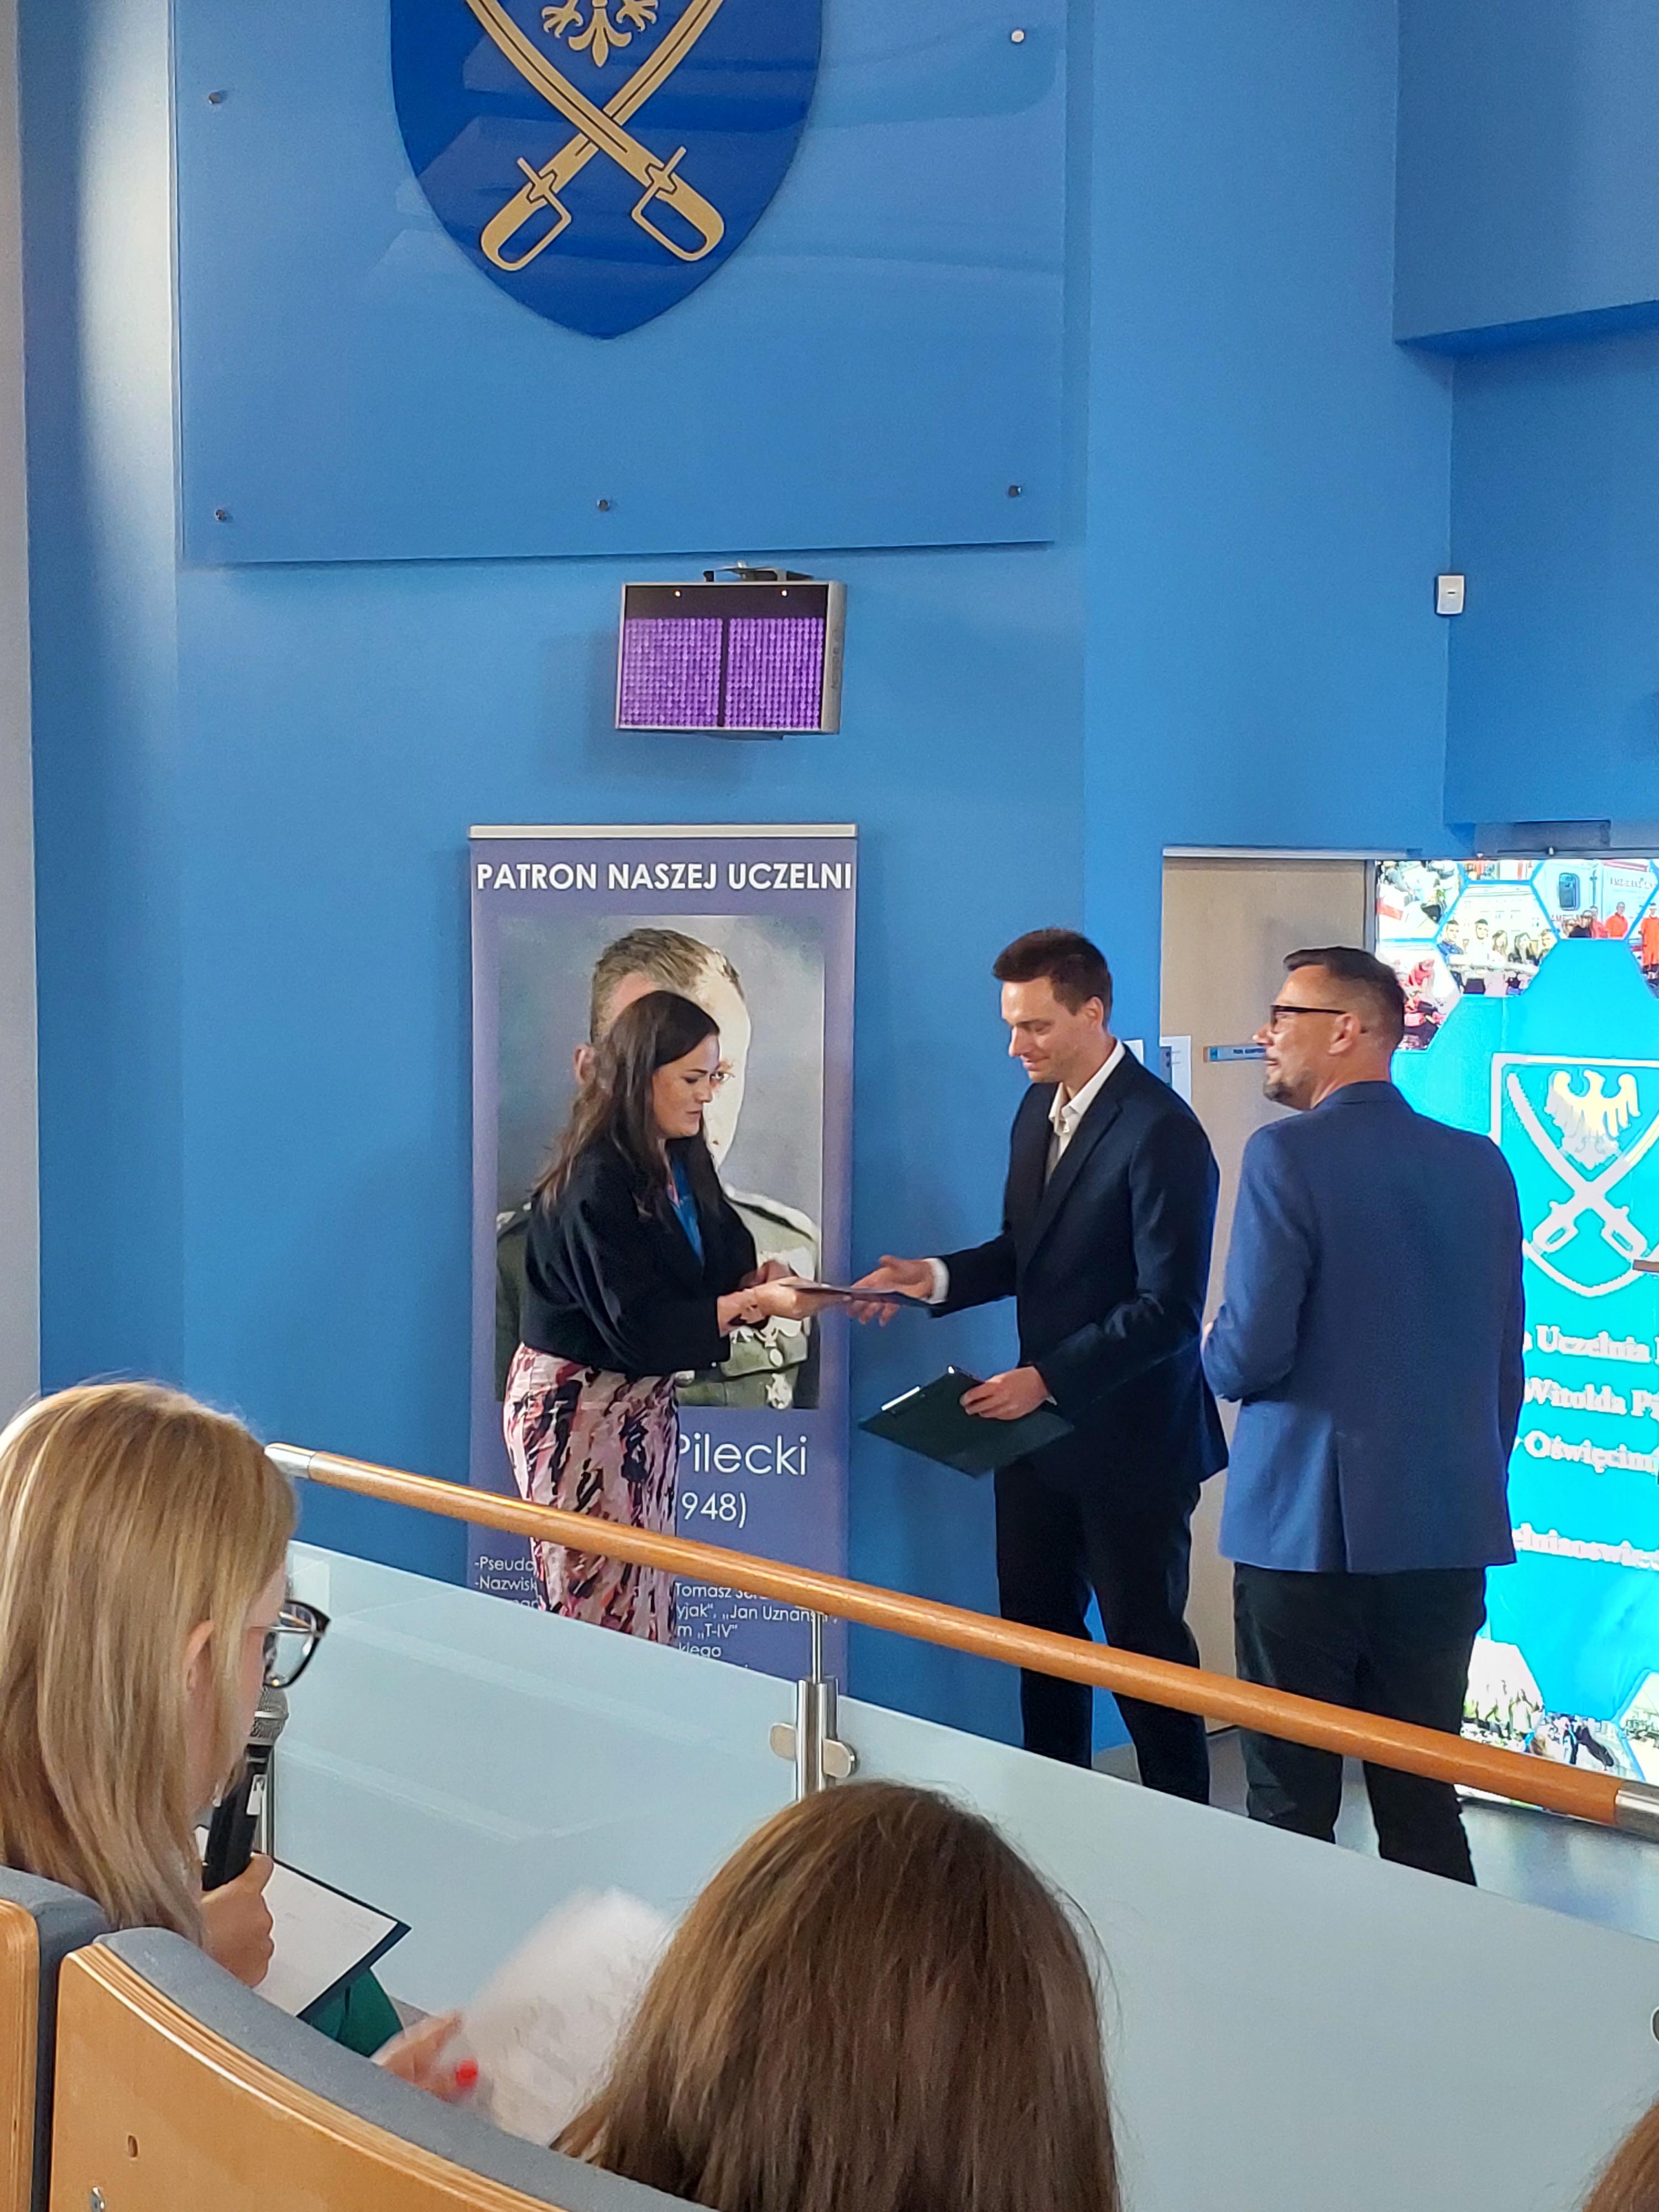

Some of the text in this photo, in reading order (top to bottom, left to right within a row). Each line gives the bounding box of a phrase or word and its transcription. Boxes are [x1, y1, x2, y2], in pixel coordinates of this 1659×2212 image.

[477, 863, 851, 890] PATRON NASZEJ UCZELNI
[1536, 1324, 1651, 1362] Uczelnia
